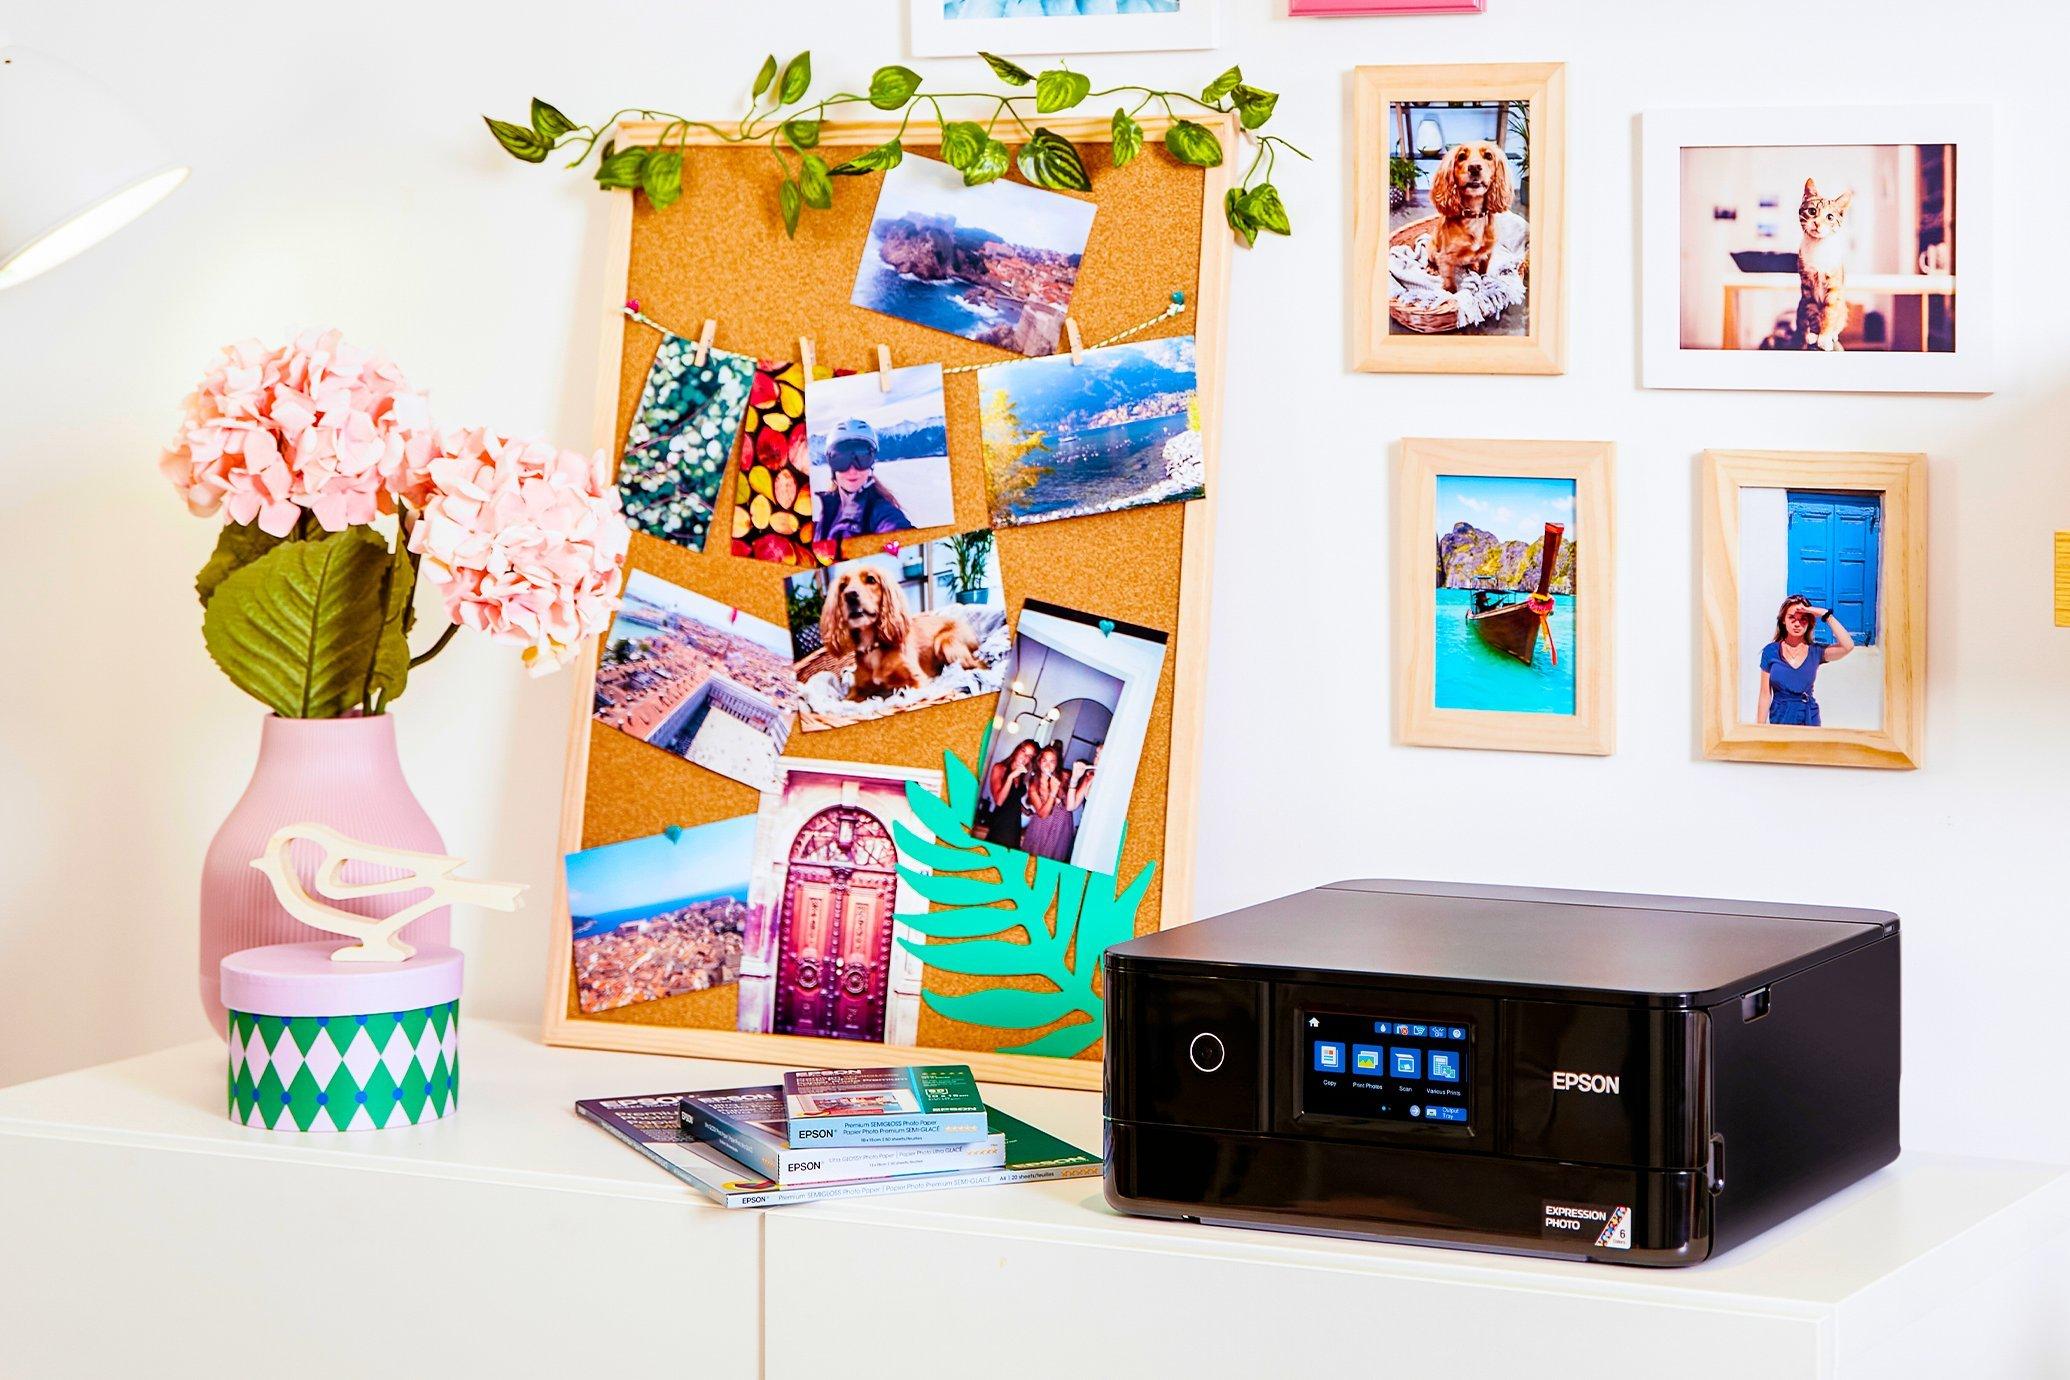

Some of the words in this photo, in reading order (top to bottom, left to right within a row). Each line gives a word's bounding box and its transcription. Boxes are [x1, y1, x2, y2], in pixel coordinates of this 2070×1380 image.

[1322, 1079, 1337, 1088] Copy
[1352, 1081, 1365, 1089] Print
[1552, 1071, 1620, 1095] EPSON
[1426, 1087, 1446, 1095] Various
[1442, 1107, 1459, 1115] Output
[798, 1129, 834, 1139] EPSON
[788, 1161, 821, 1172] EPSON
[742, 1196, 766, 1205] EPSON
[778, 1193, 805, 1201] Premium
[806, 1190, 842, 1200] SEMIGLOSS
[843, 1188, 860, 1197] Photo
[861, 1187, 879, 1196] Paper
[906, 1181, 924, 1190] Photo
[925, 1178, 953, 1188] Premium
[1545, 1205, 1607, 1221] EXPRESSION
[1545, 1219, 1581, 1231] PHOTO
[1619, 1229, 1626, 1239] 6
